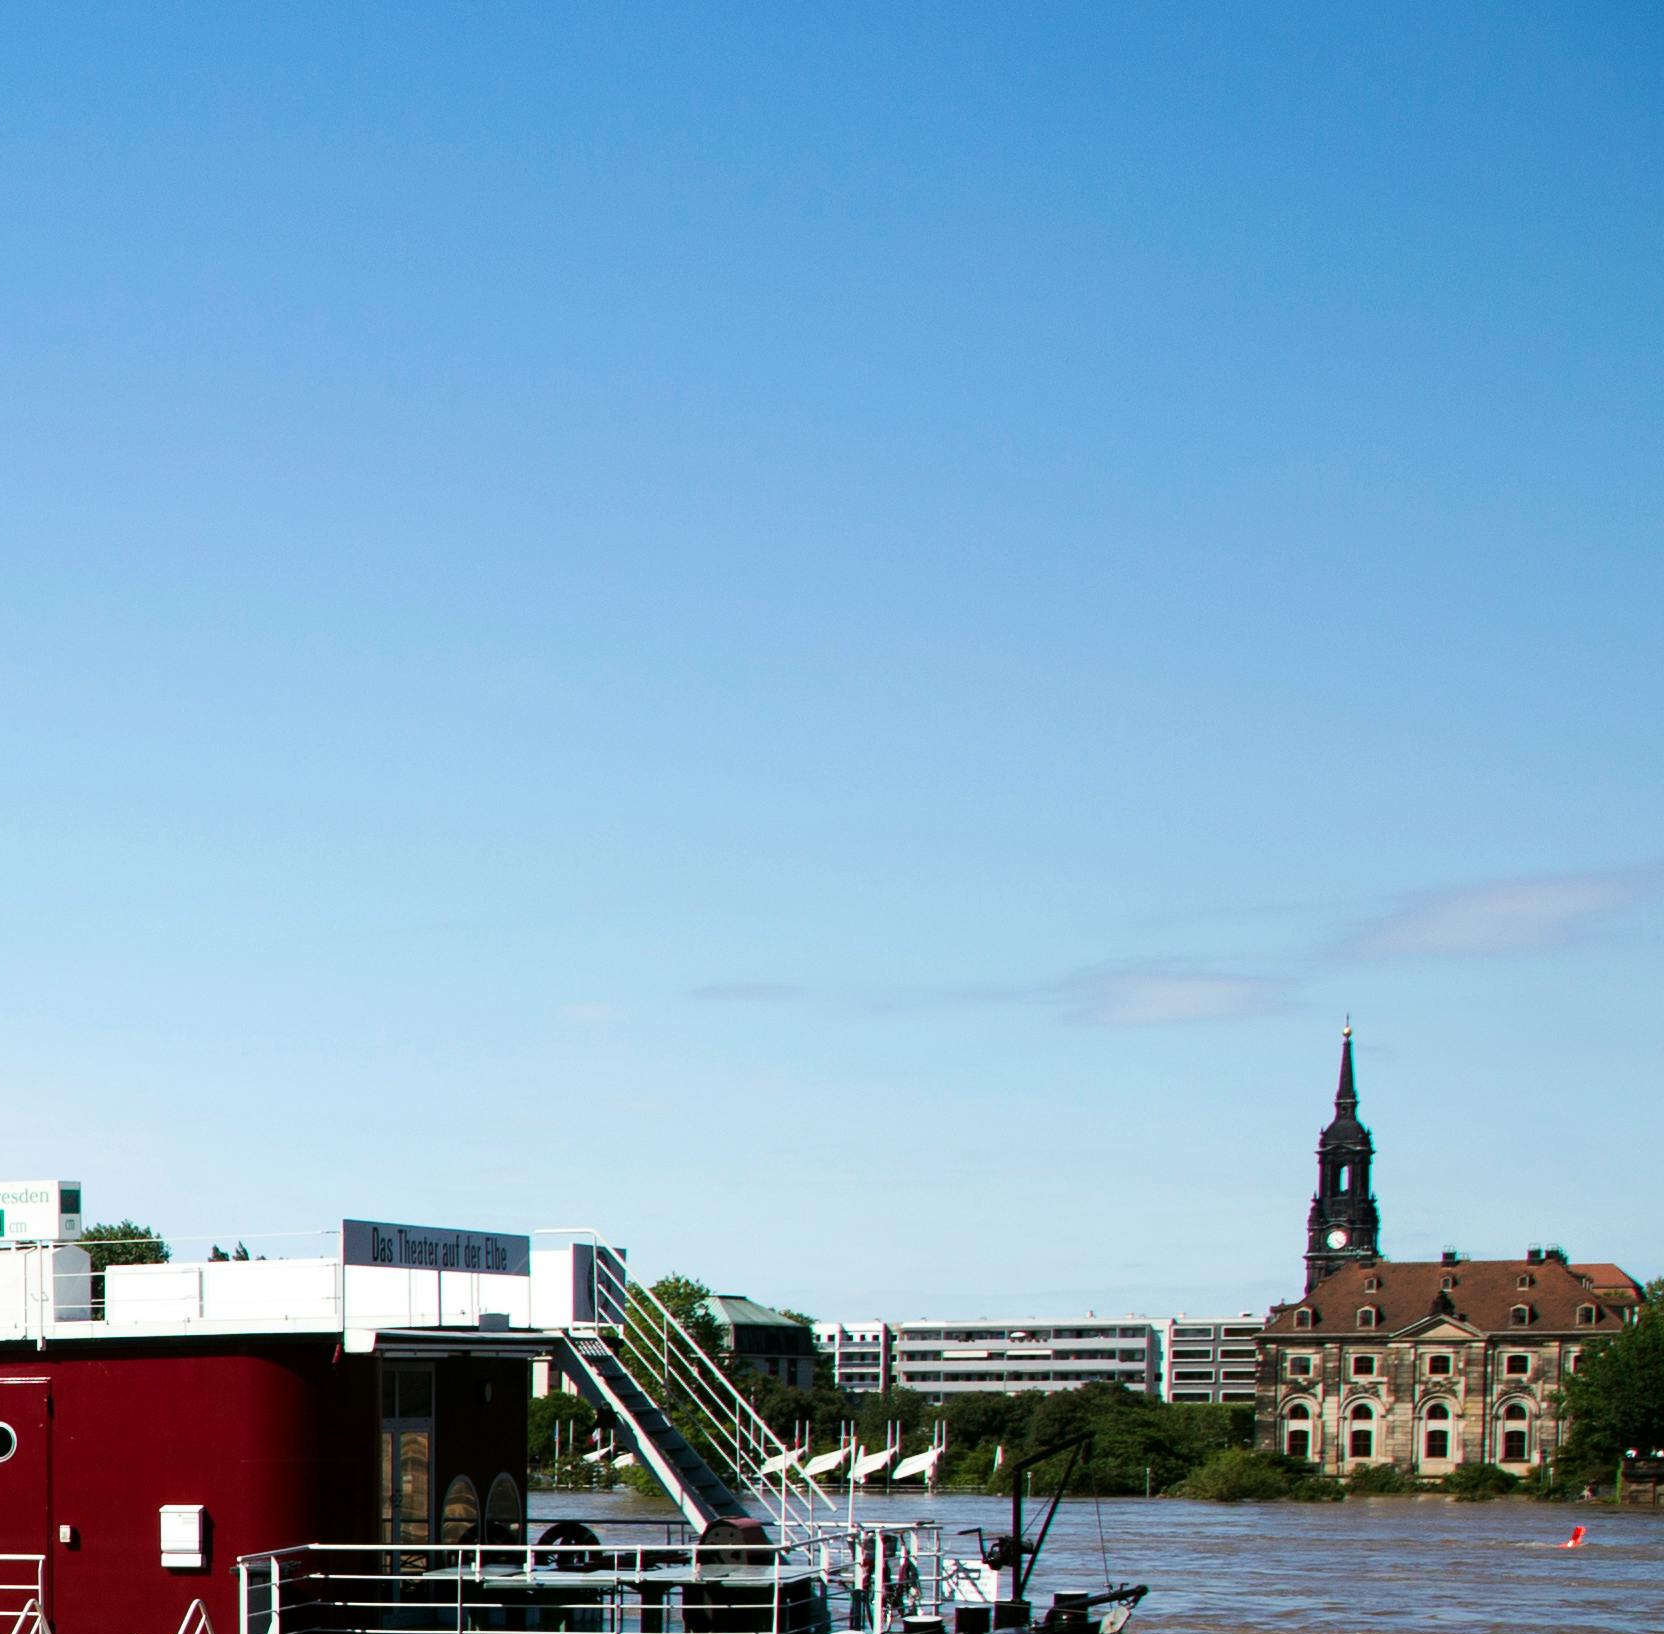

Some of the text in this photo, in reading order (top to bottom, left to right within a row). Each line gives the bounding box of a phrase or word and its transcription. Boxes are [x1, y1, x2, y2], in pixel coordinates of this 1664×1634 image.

[9, 1221, 28, 1233] cm
[372, 1227, 508, 1271] Das Theater auf der Elbe
